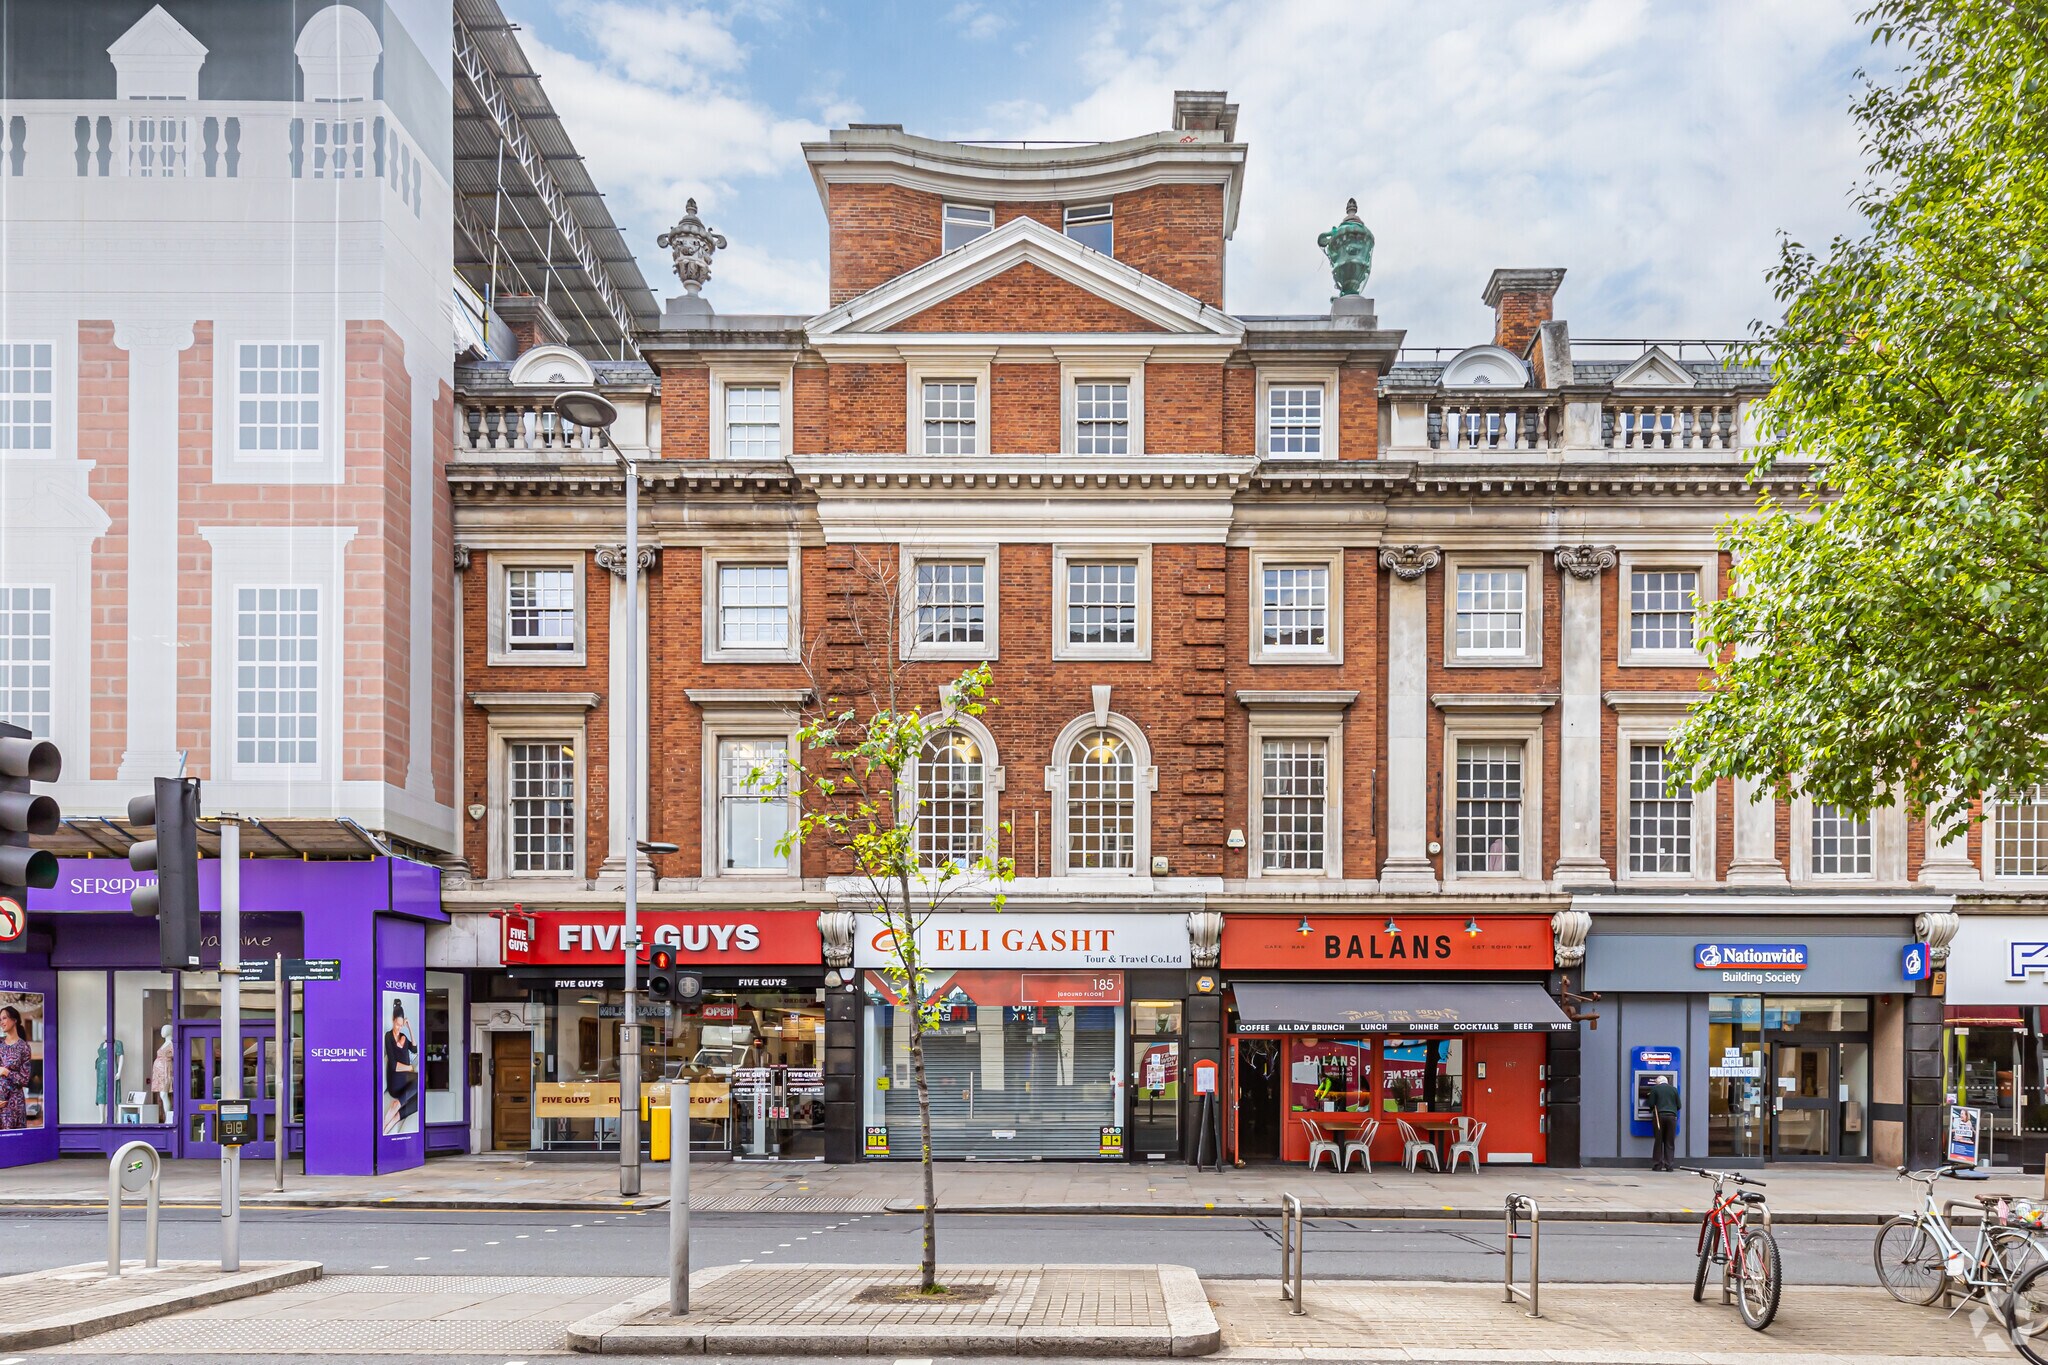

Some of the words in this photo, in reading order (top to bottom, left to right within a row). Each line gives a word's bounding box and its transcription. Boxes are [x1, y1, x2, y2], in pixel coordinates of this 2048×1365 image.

[510, 927, 527, 941] FIVE
[654, 924, 760, 951] GUYS
[936, 929, 991, 951] ELI
[1001, 929, 1115, 951] GASHT
[508, 939, 529, 953] GUYS
[1325, 935, 1452, 959] BALANS
[1084, 955, 1107, 963] Tour
[1108, 955, 1117, 963] &
[1120, 955, 1148, 963] Travel
[1150, 955, 1182, 964] Co.Ltd
[1723, 948, 1803, 963] Nationwide
[1093, 978, 1114, 990] 185
[1722, 972, 1763, 984] Building
[1765, 972, 1801, 984] Society
[705, 1006, 735, 1017] OPEN
[1303, 1055, 1357, 1067] BALANS
